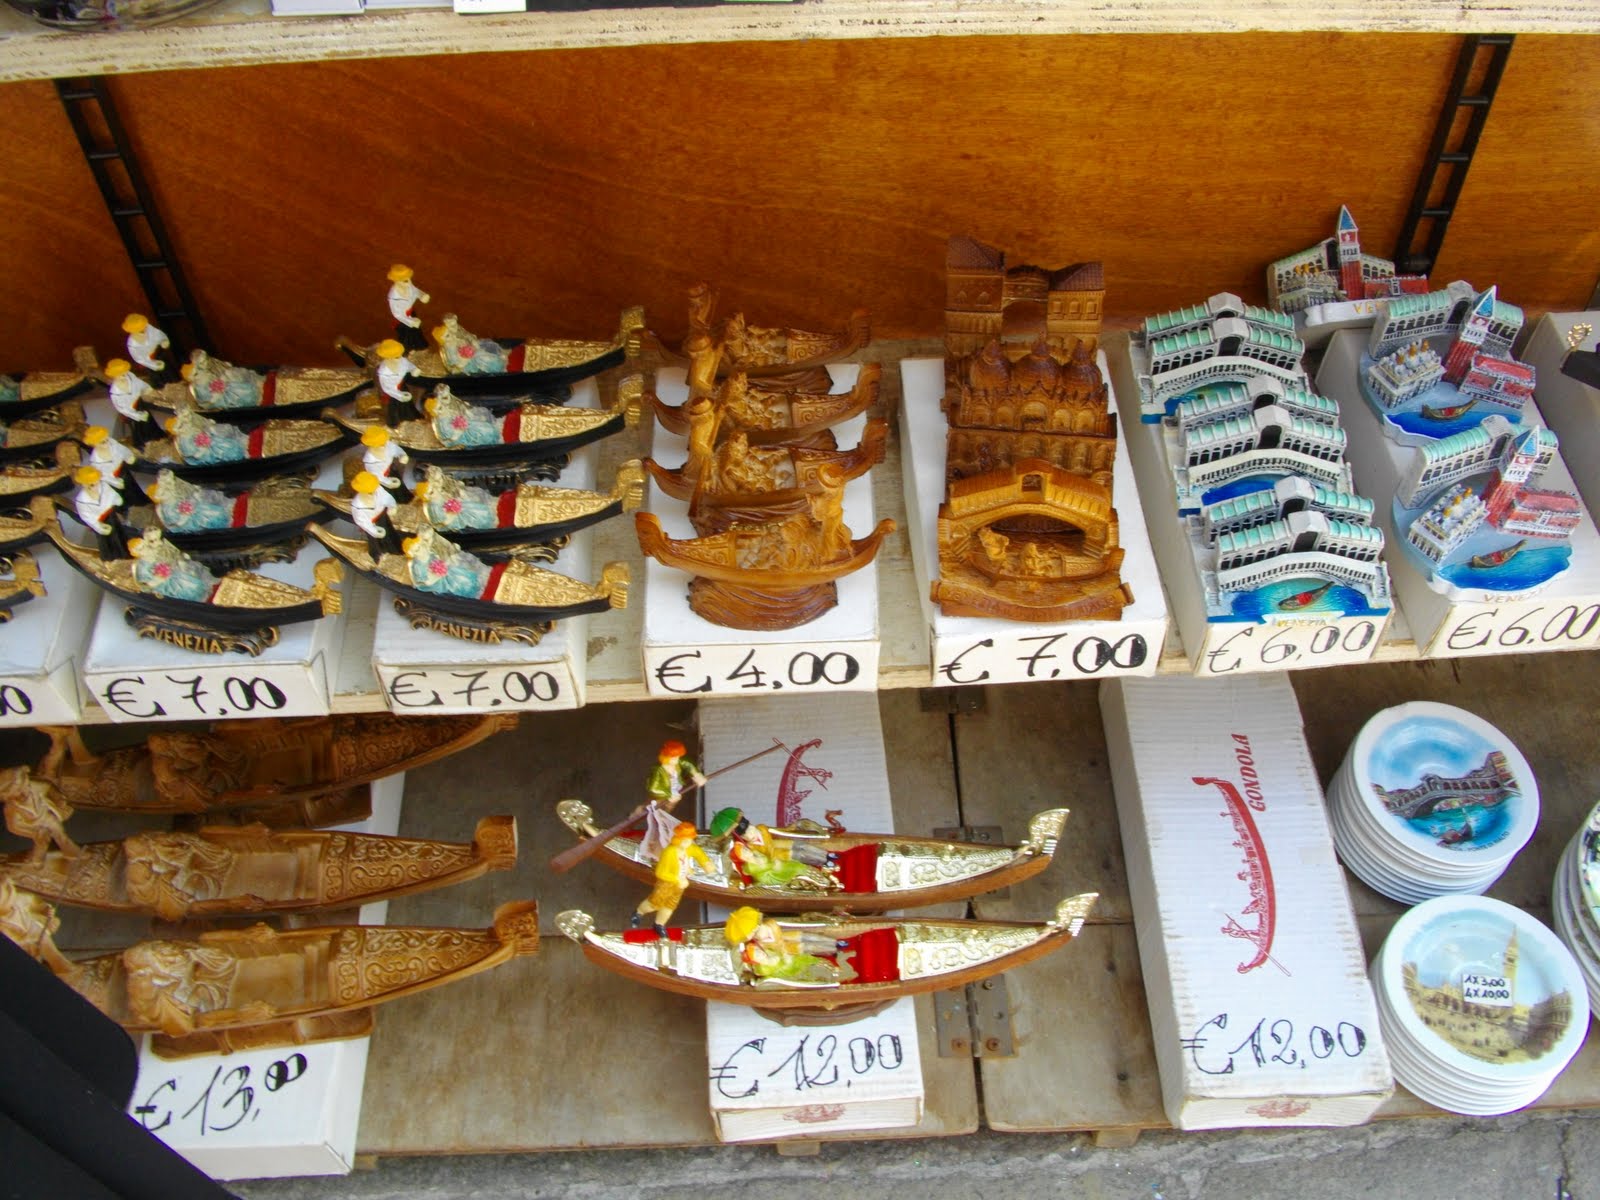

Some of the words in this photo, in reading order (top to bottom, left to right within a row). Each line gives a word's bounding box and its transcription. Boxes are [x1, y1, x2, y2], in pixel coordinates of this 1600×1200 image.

[154, 627, 224, 656] VENEZIA
[430, 618, 501, 645] VENEZIA
[1231, 733, 1266, 812] GONDOLA
